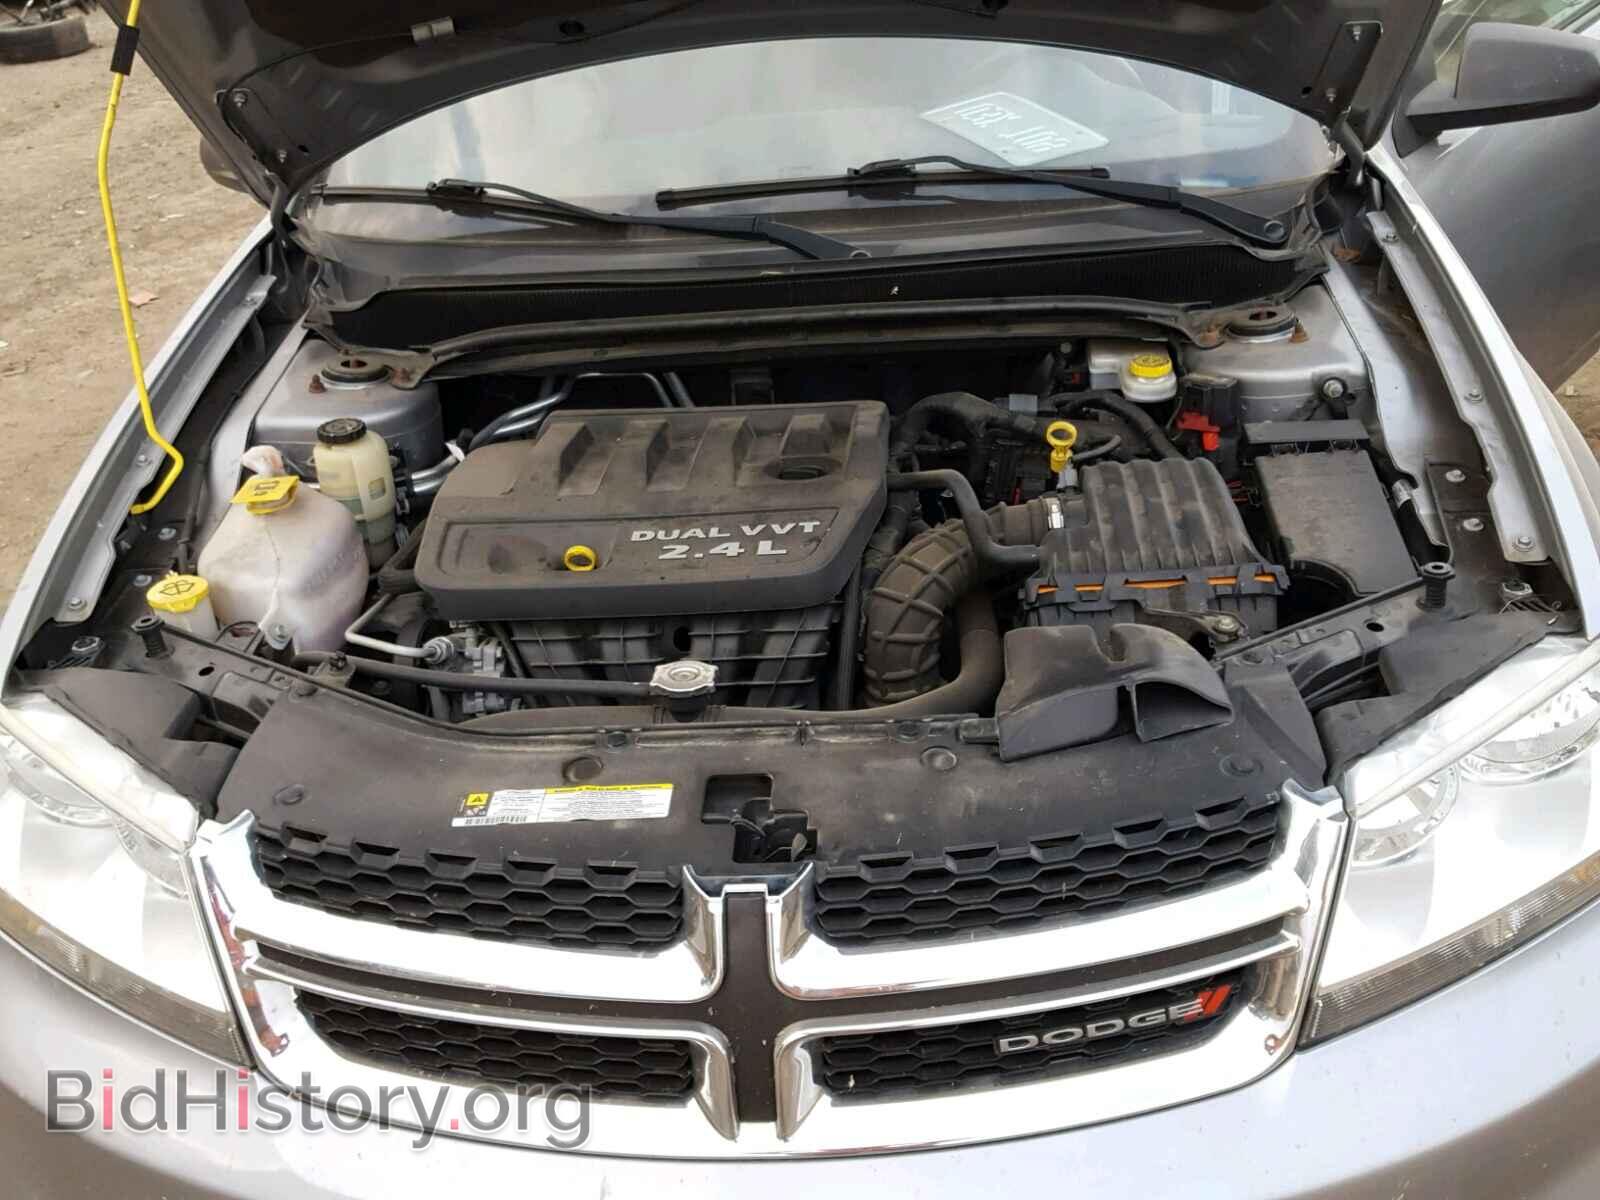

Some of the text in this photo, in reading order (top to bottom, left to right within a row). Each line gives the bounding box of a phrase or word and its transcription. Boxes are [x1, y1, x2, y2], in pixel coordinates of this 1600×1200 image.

[630, 521, 821, 542] DUAL VVT
[999, 998, 1206, 1053] DODGE
